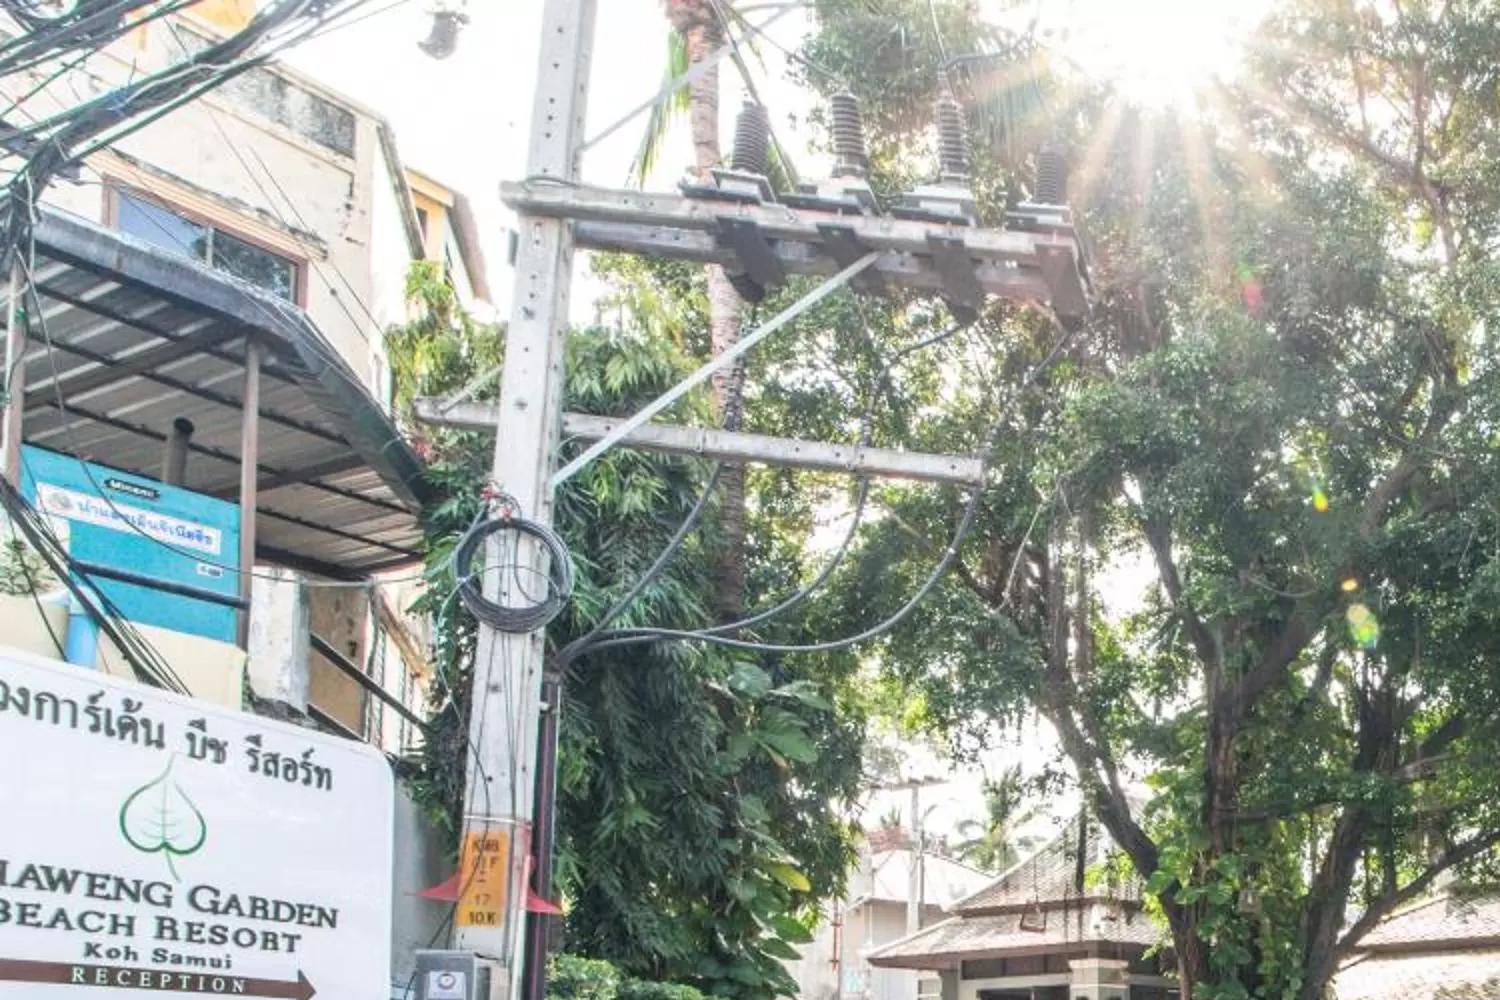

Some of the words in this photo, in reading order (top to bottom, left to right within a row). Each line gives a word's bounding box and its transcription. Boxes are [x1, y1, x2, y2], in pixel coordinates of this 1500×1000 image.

[245, 733, 334, 791] รีสอร์ท
[187, 884, 339, 929] GARDEN
[153, 914, 302, 953] RESORT
[83, 940, 139, 963] Koh
[151, 947, 233, 970] Samui
[70, 967, 247, 994] RECEPTION
